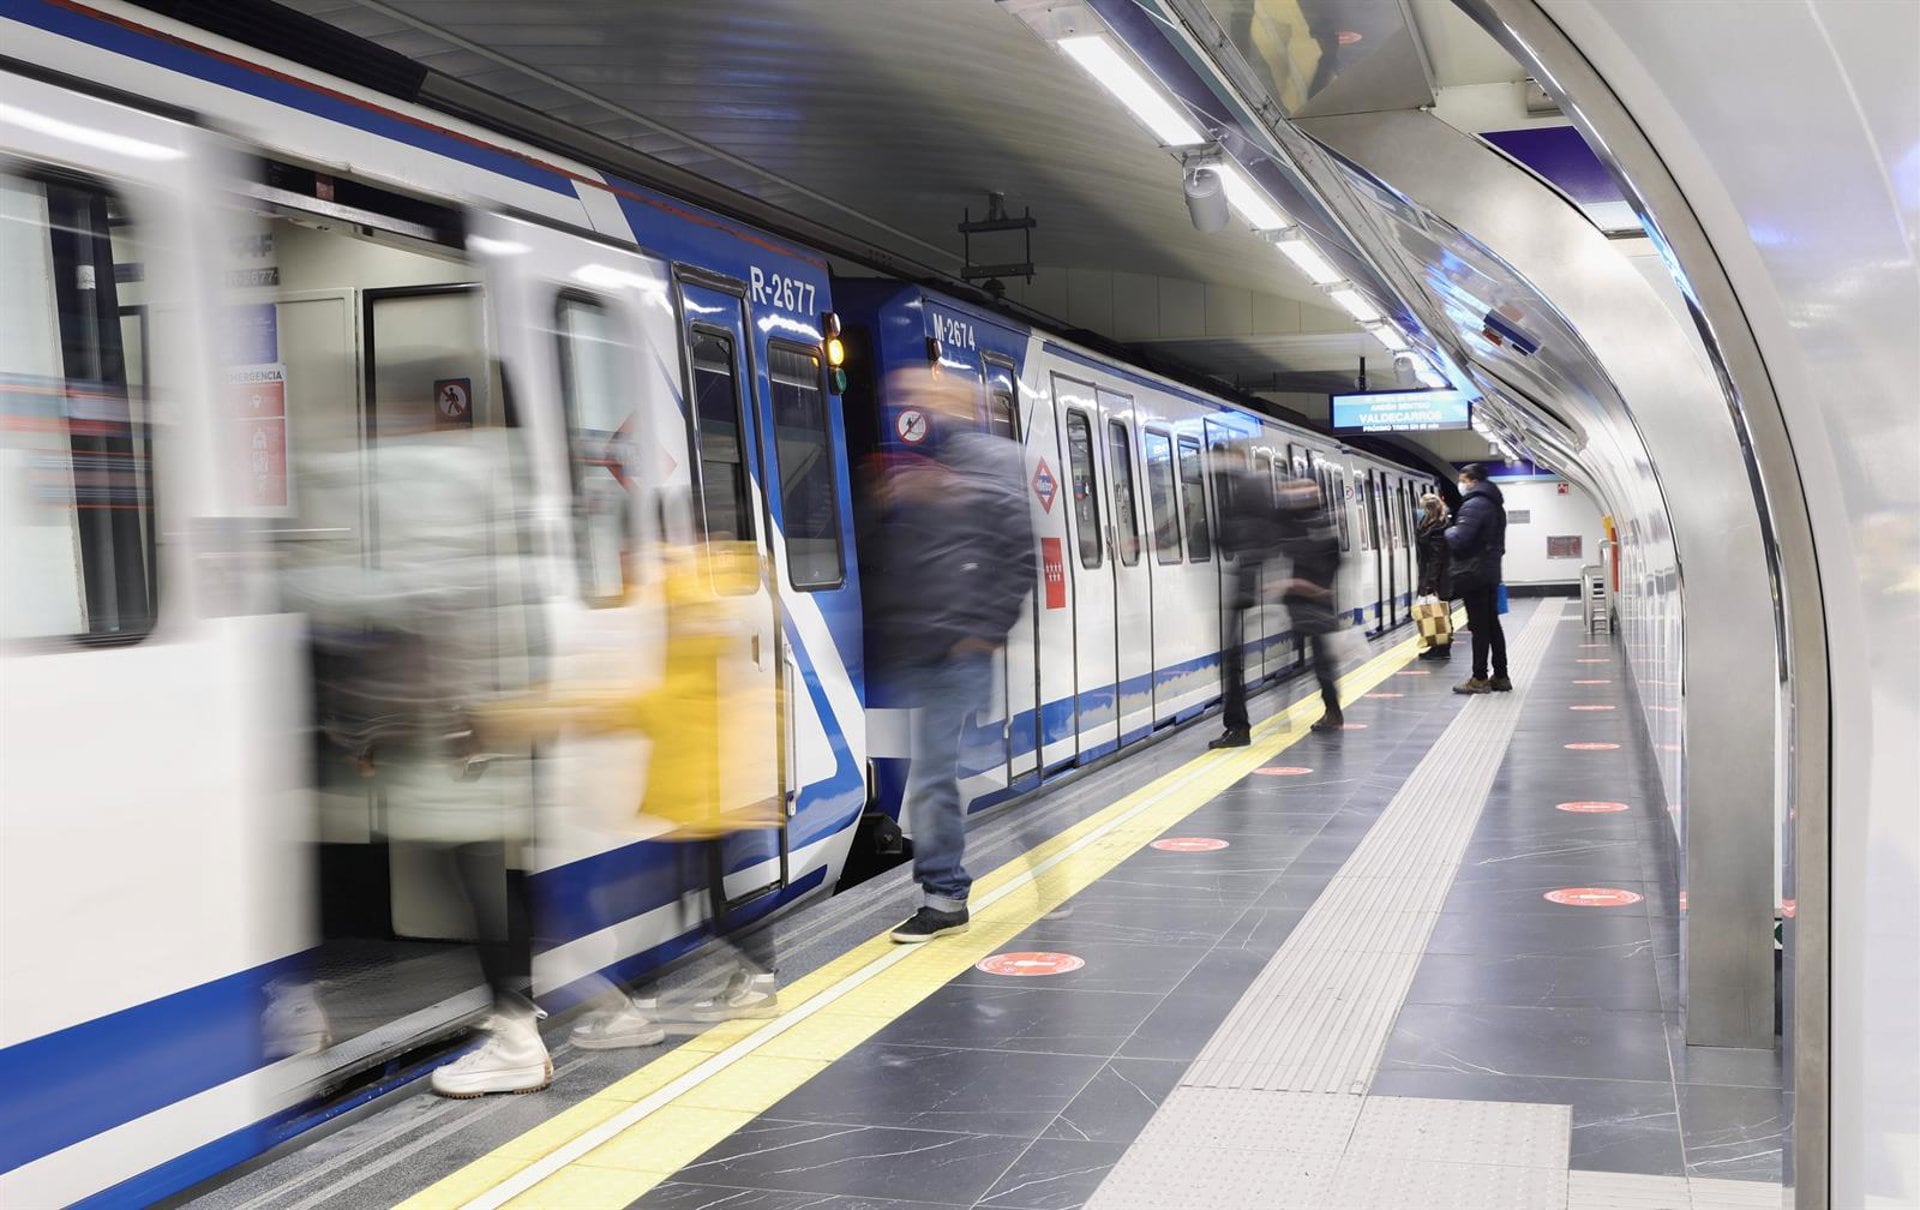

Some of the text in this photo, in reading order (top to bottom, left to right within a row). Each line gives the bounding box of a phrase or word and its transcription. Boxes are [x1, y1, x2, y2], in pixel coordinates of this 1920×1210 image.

[750, 265, 816, 316] R-2677
[932, 312, 976, 351] M-2674
[225, 370, 284, 383] MERGENCIA
[1358, 411, 1442, 423] VALDECARROS
